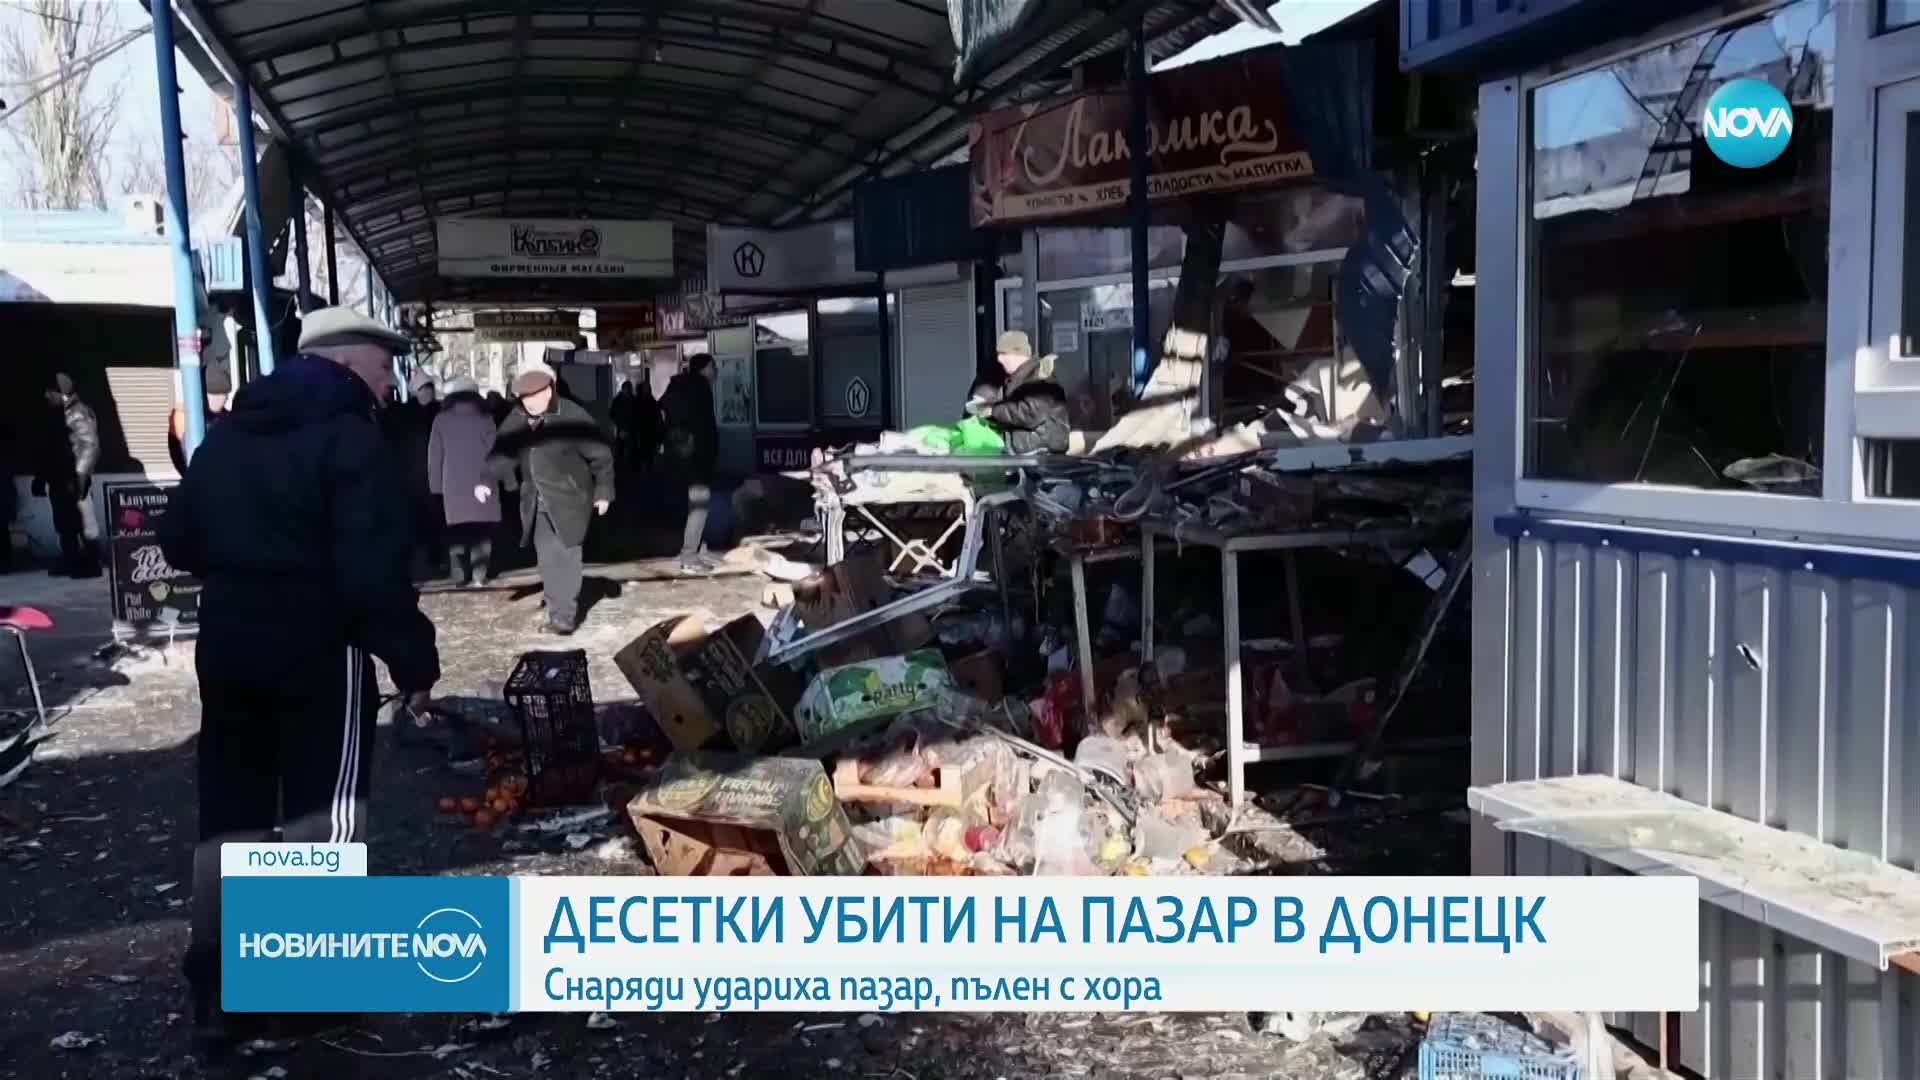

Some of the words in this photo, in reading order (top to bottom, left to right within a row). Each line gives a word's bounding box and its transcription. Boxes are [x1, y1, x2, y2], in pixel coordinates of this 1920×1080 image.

[1233, 158, 1304, 180] НАПИТКИ
[490, 263, 567, 274] ФИРМЕННЫЙ
[571, 263, 625, 274] МАГАЗИН
